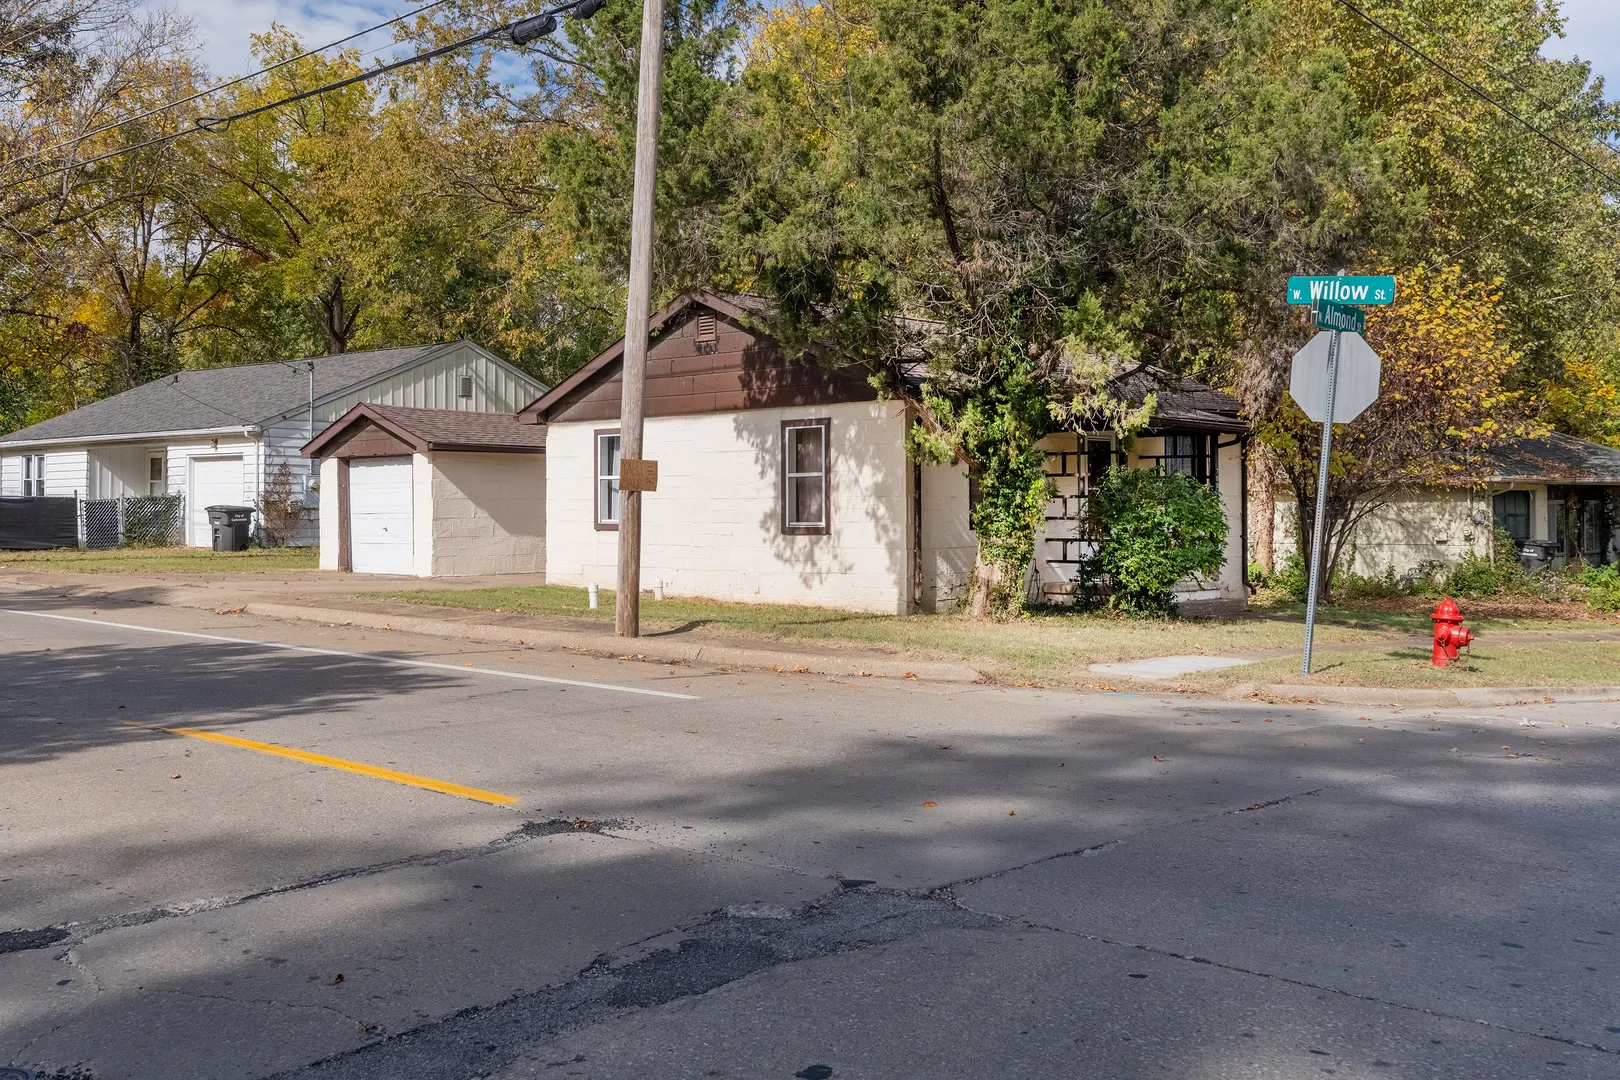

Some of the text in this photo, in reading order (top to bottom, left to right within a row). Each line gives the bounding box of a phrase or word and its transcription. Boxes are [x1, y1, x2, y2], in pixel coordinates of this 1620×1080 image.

[1293, 280, 1387, 300] W. Willow St.
[1324, 304, 1357, 331] Almond
